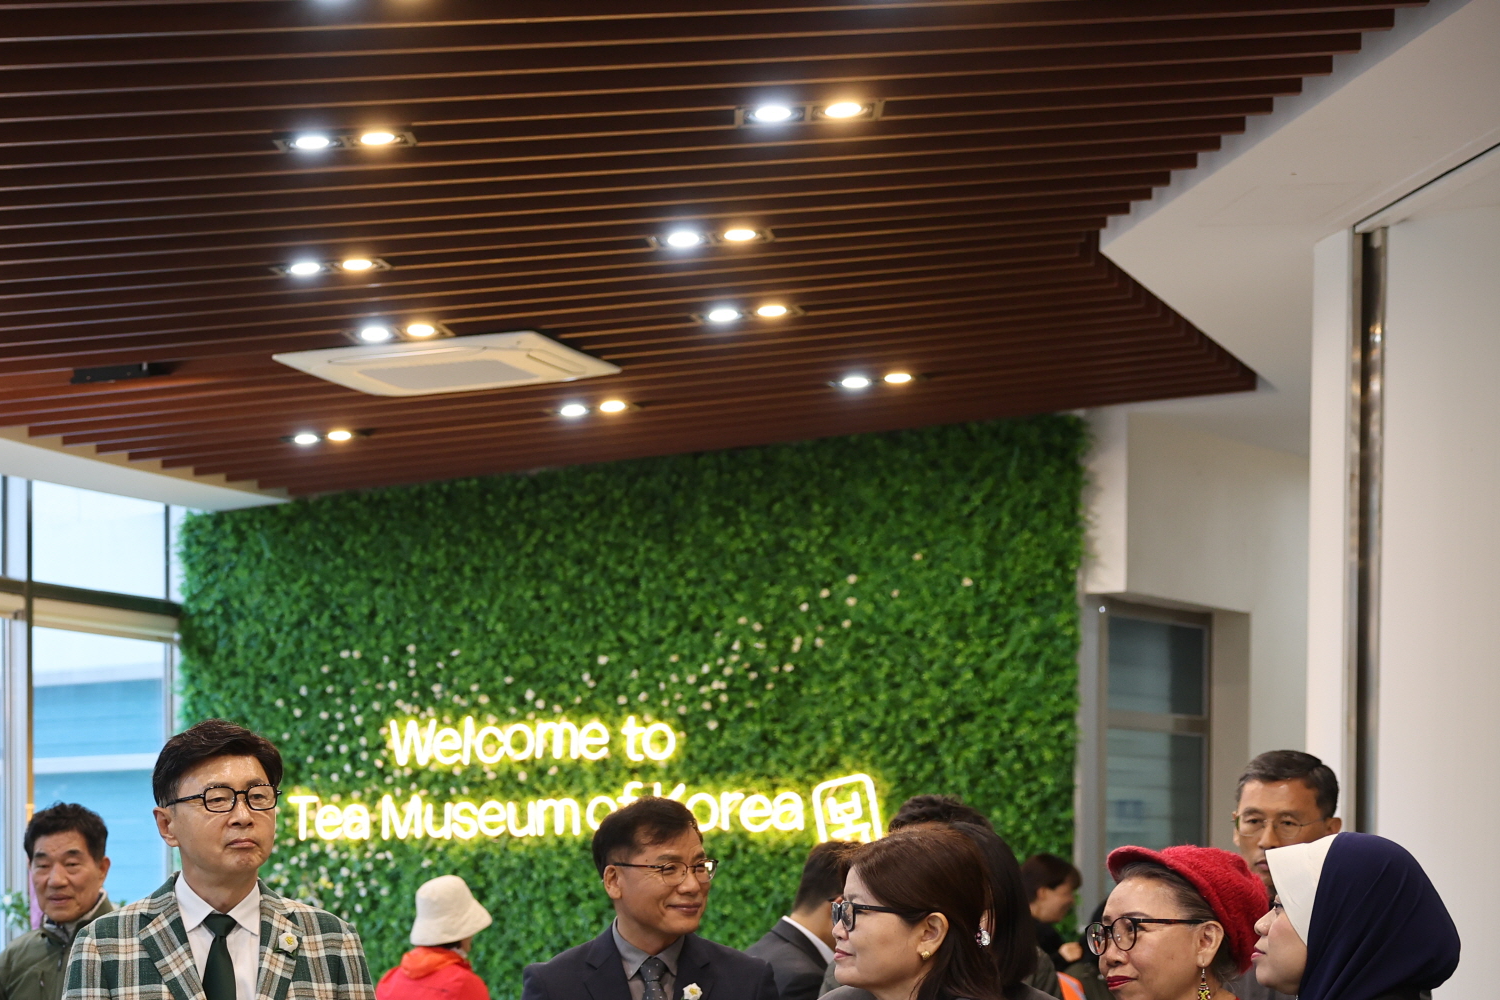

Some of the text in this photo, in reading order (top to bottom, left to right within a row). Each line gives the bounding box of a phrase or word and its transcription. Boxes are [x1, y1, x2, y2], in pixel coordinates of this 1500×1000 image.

[389, 715, 677, 767] Welcome to
[287, 795, 370, 841] Tea
[381, 794, 581, 840] Museum
